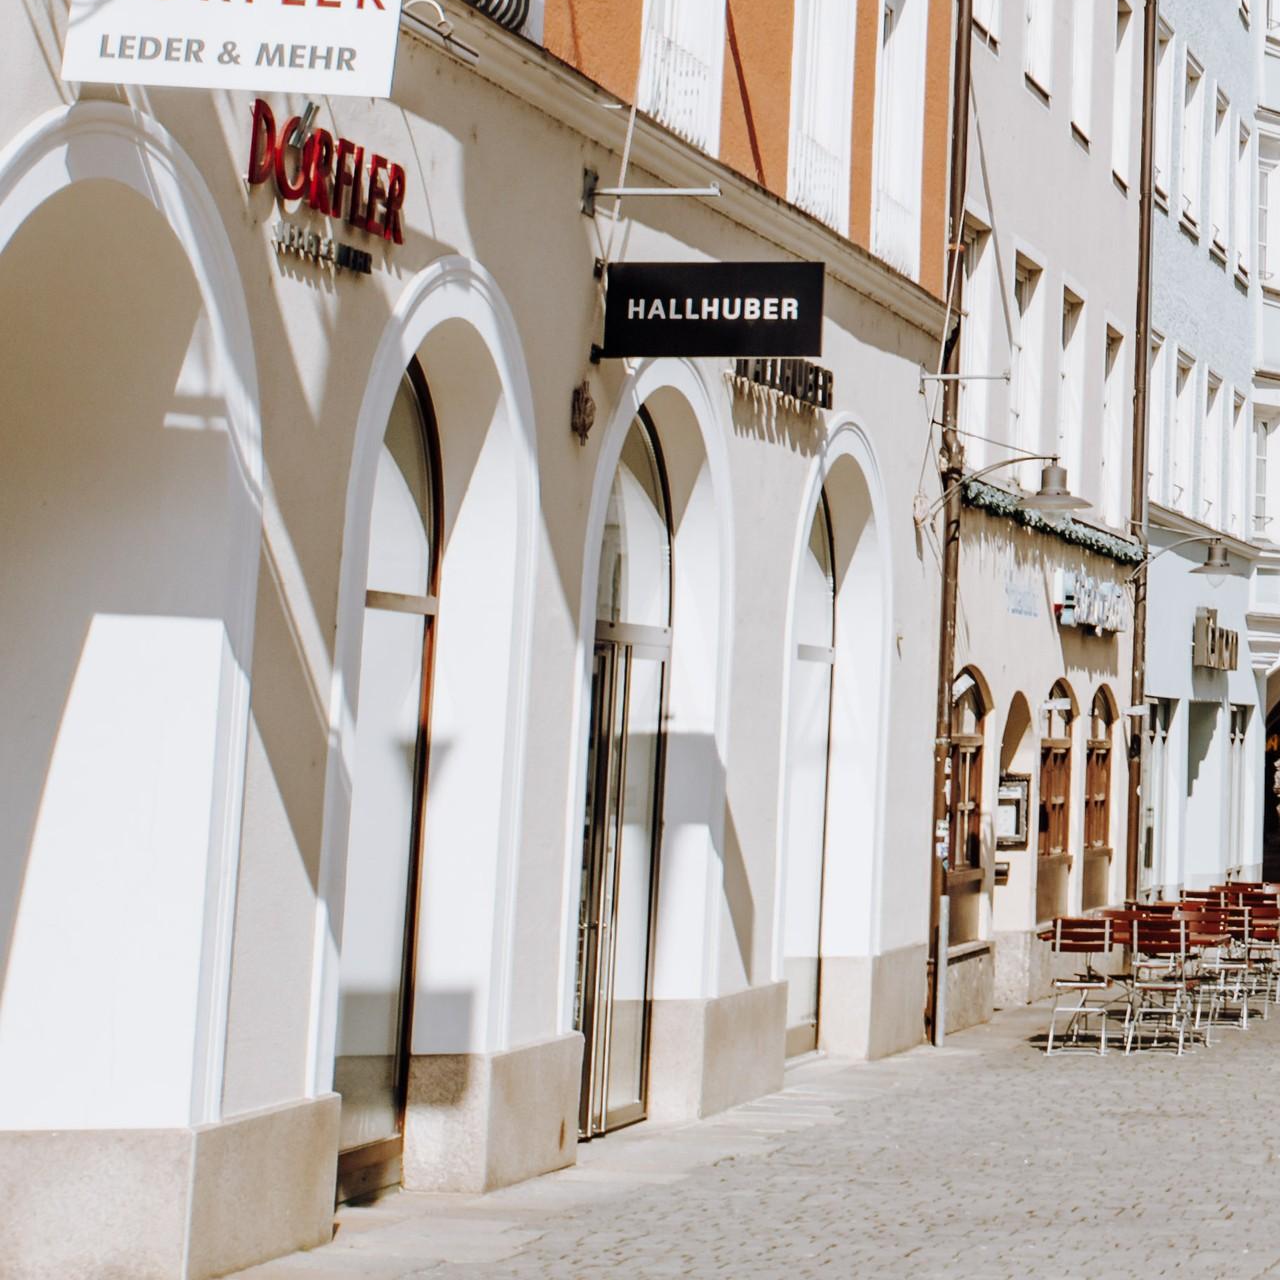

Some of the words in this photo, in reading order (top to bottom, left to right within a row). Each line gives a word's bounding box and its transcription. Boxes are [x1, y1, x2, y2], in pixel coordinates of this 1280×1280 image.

[99, 33, 206, 64] LEDER
[217, 40, 241, 65] &
[254, 42, 357, 71] MEHR
[247, 98, 406, 245] DÖRFLER
[628, 297, 799, 321] HALLHUBER
